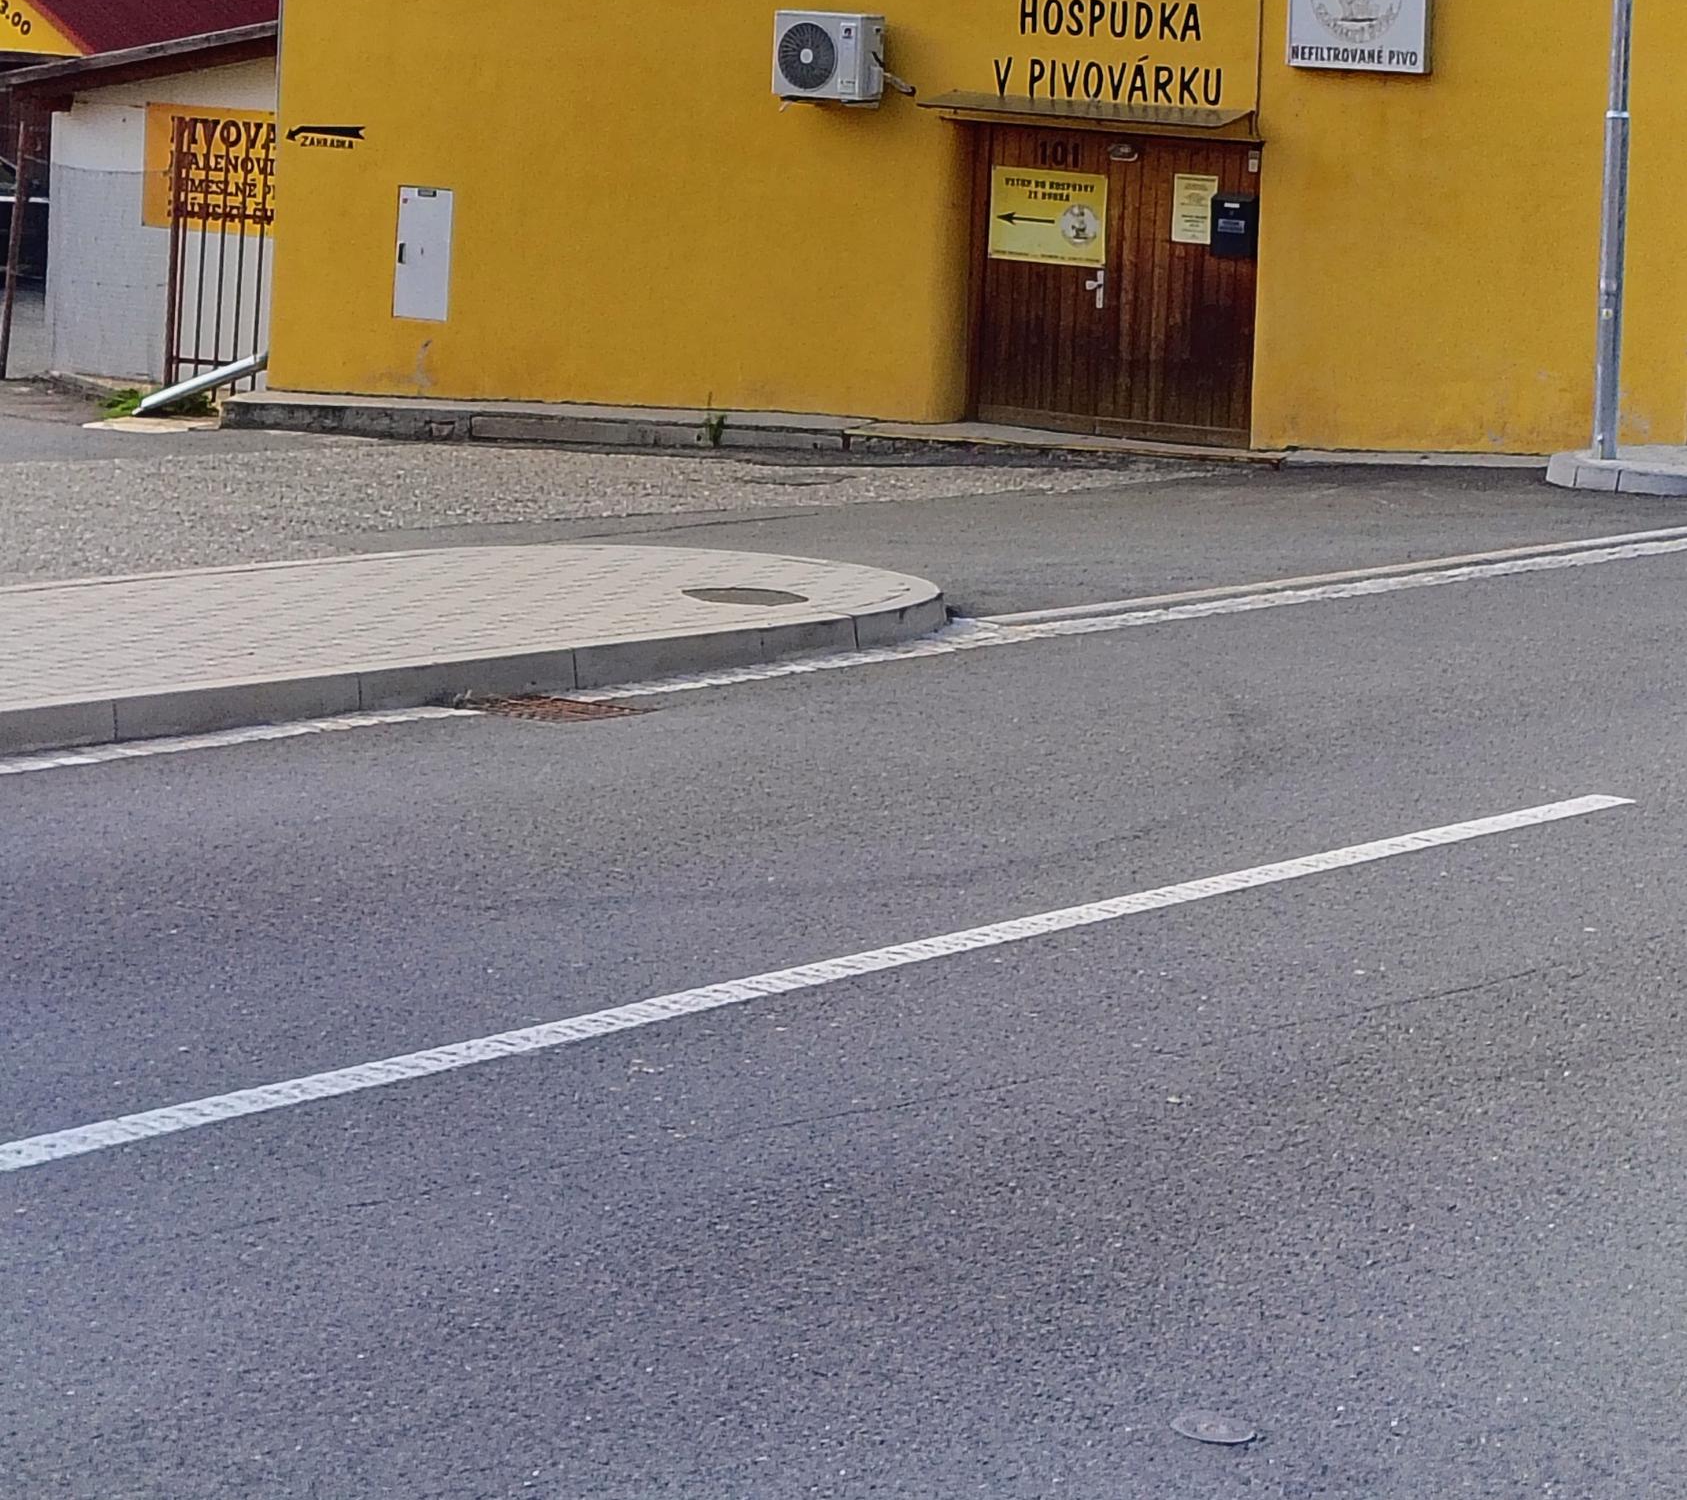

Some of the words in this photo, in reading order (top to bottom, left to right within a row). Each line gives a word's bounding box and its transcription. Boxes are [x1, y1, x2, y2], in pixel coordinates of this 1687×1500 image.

[1291, 45, 1384, 64] NEFILTROVANÉ
[1388, 51, 1418, 66] PIVO
[994, 56, 1012, 98] V
[1029, 55, 1222, 106] PIVOVÁRKU
[168, 150, 276, 176] ALENOVI
[1041, 141, 1081, 168] 101
